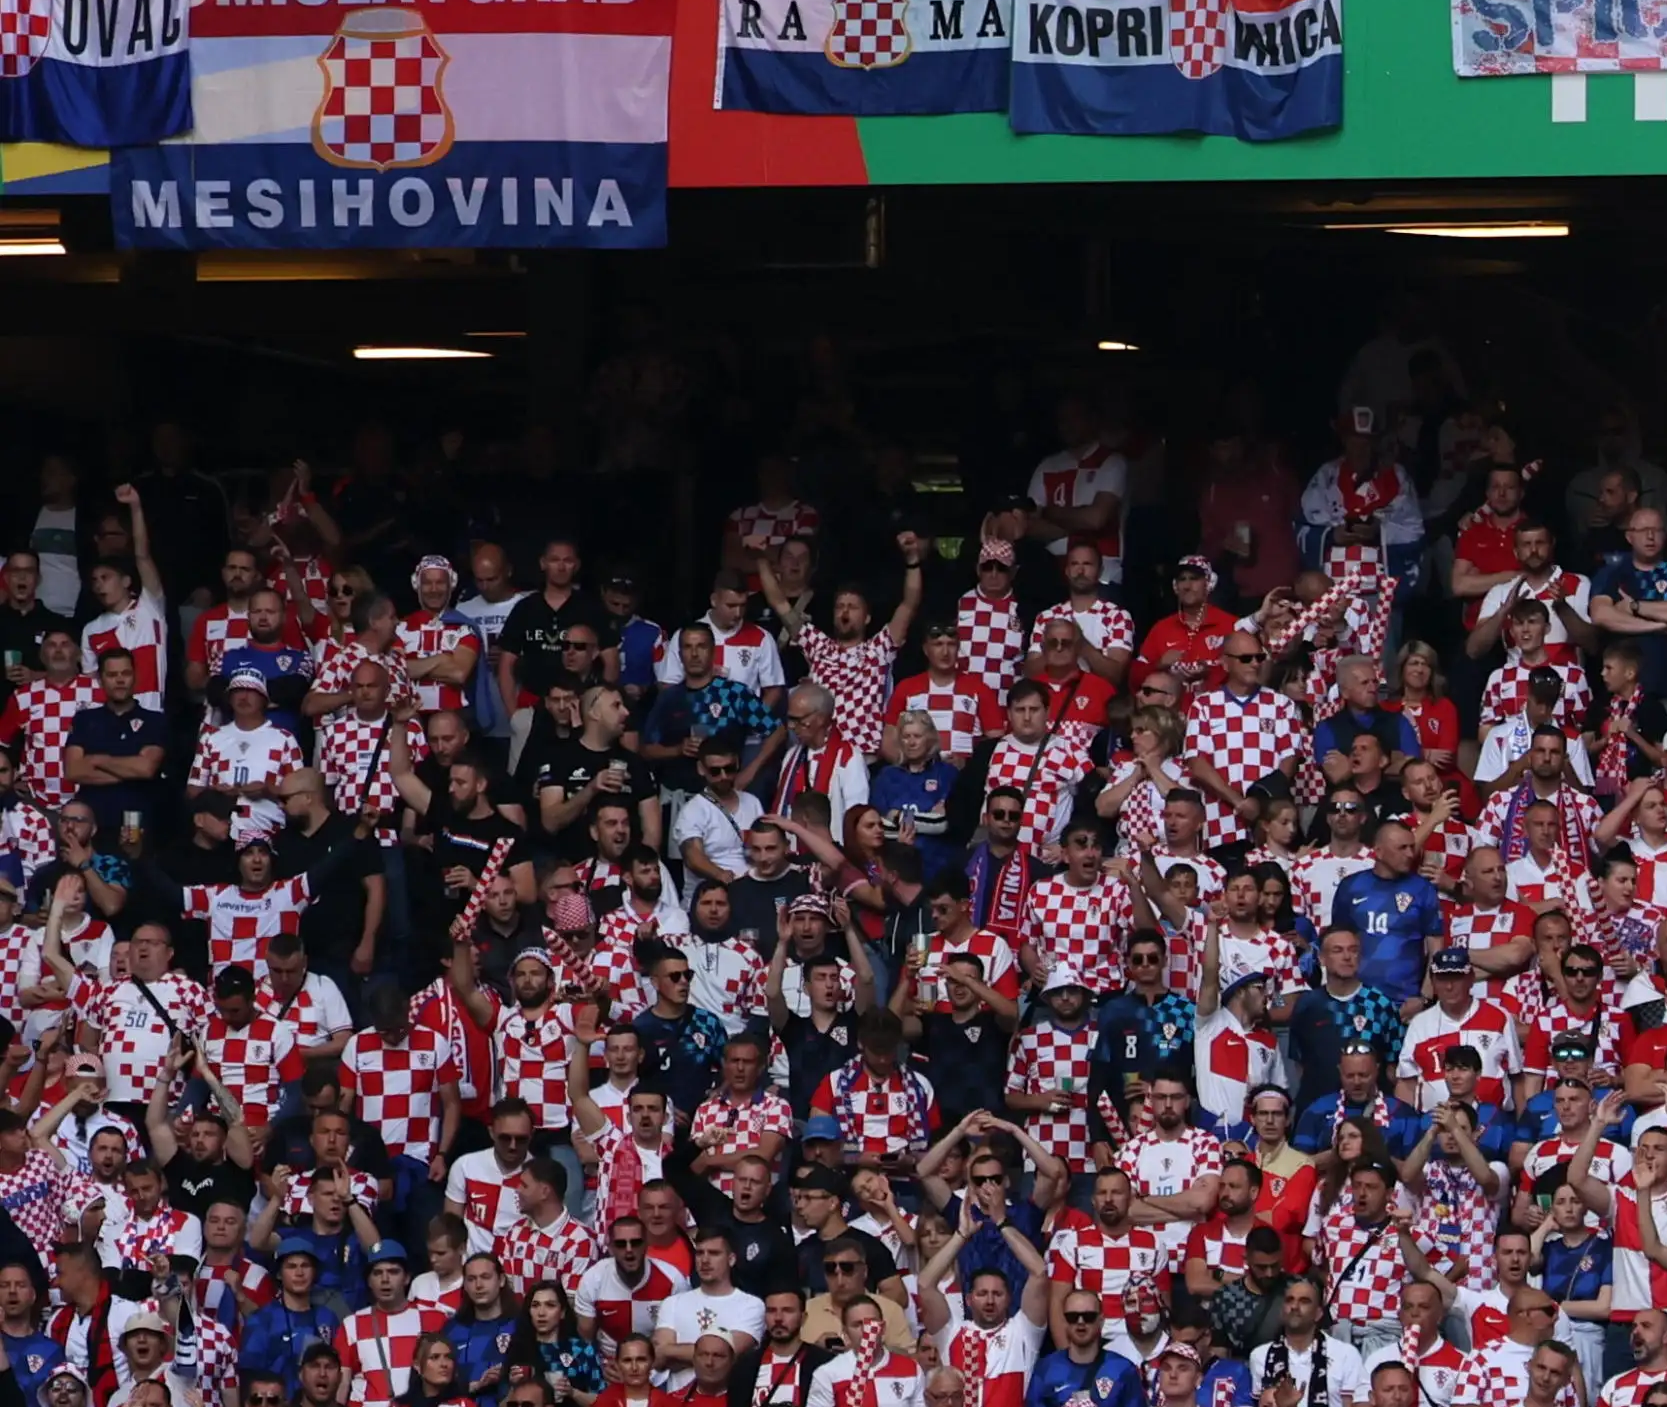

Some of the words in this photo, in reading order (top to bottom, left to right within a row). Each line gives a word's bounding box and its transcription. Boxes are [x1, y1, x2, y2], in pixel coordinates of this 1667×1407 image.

[132, 177, 632, 228] MESIHOVINA
[234, 766, 249, 785] 10
[124, 1012, 148, 1028] 50
[1125, 1034, 1137, 1059] 8
